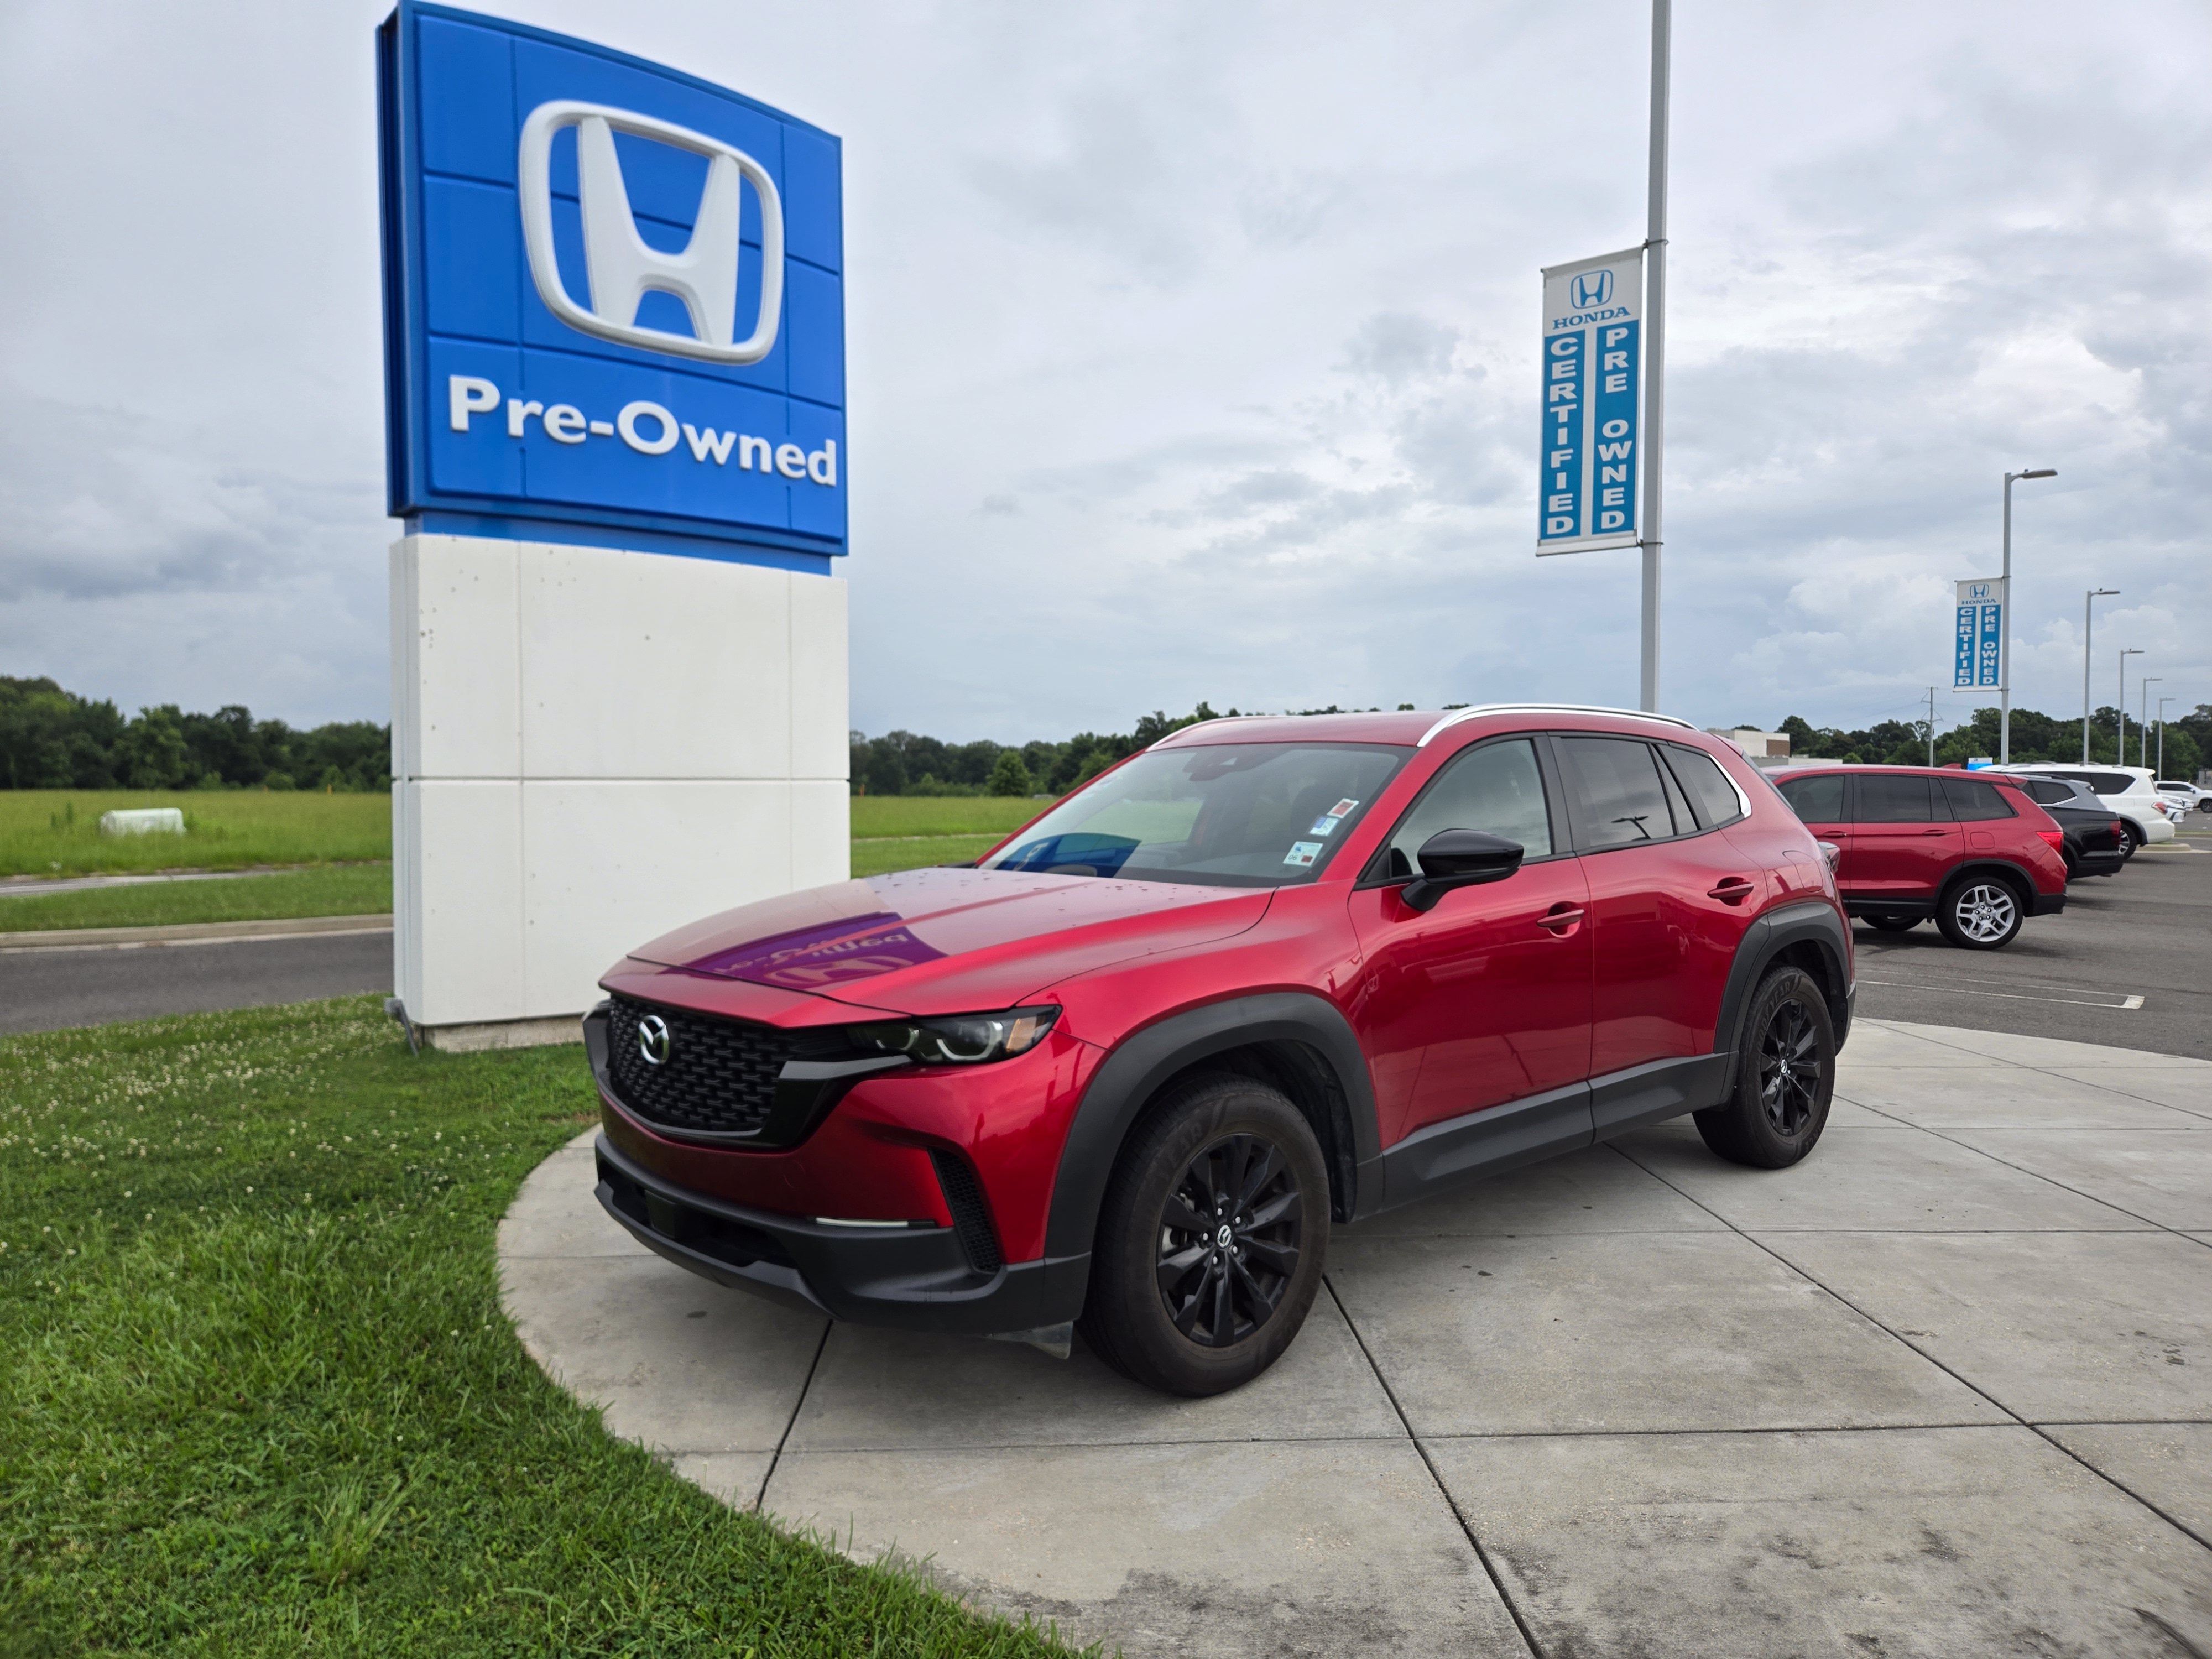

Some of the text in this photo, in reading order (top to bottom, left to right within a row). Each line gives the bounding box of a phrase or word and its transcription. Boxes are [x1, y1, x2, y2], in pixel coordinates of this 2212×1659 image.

[1552, 306, 1631, 330] HONDA
[448, 374, 837, 487] Pre-Owned
[1546, 336, 1579, 535] CERTIFIED
[1598, 327, 1632, 529] PRE OWNED
[1958, 608, 1973, 685] CERTIFIED
[1981, 607, 1997, 684] PRE OWNED
